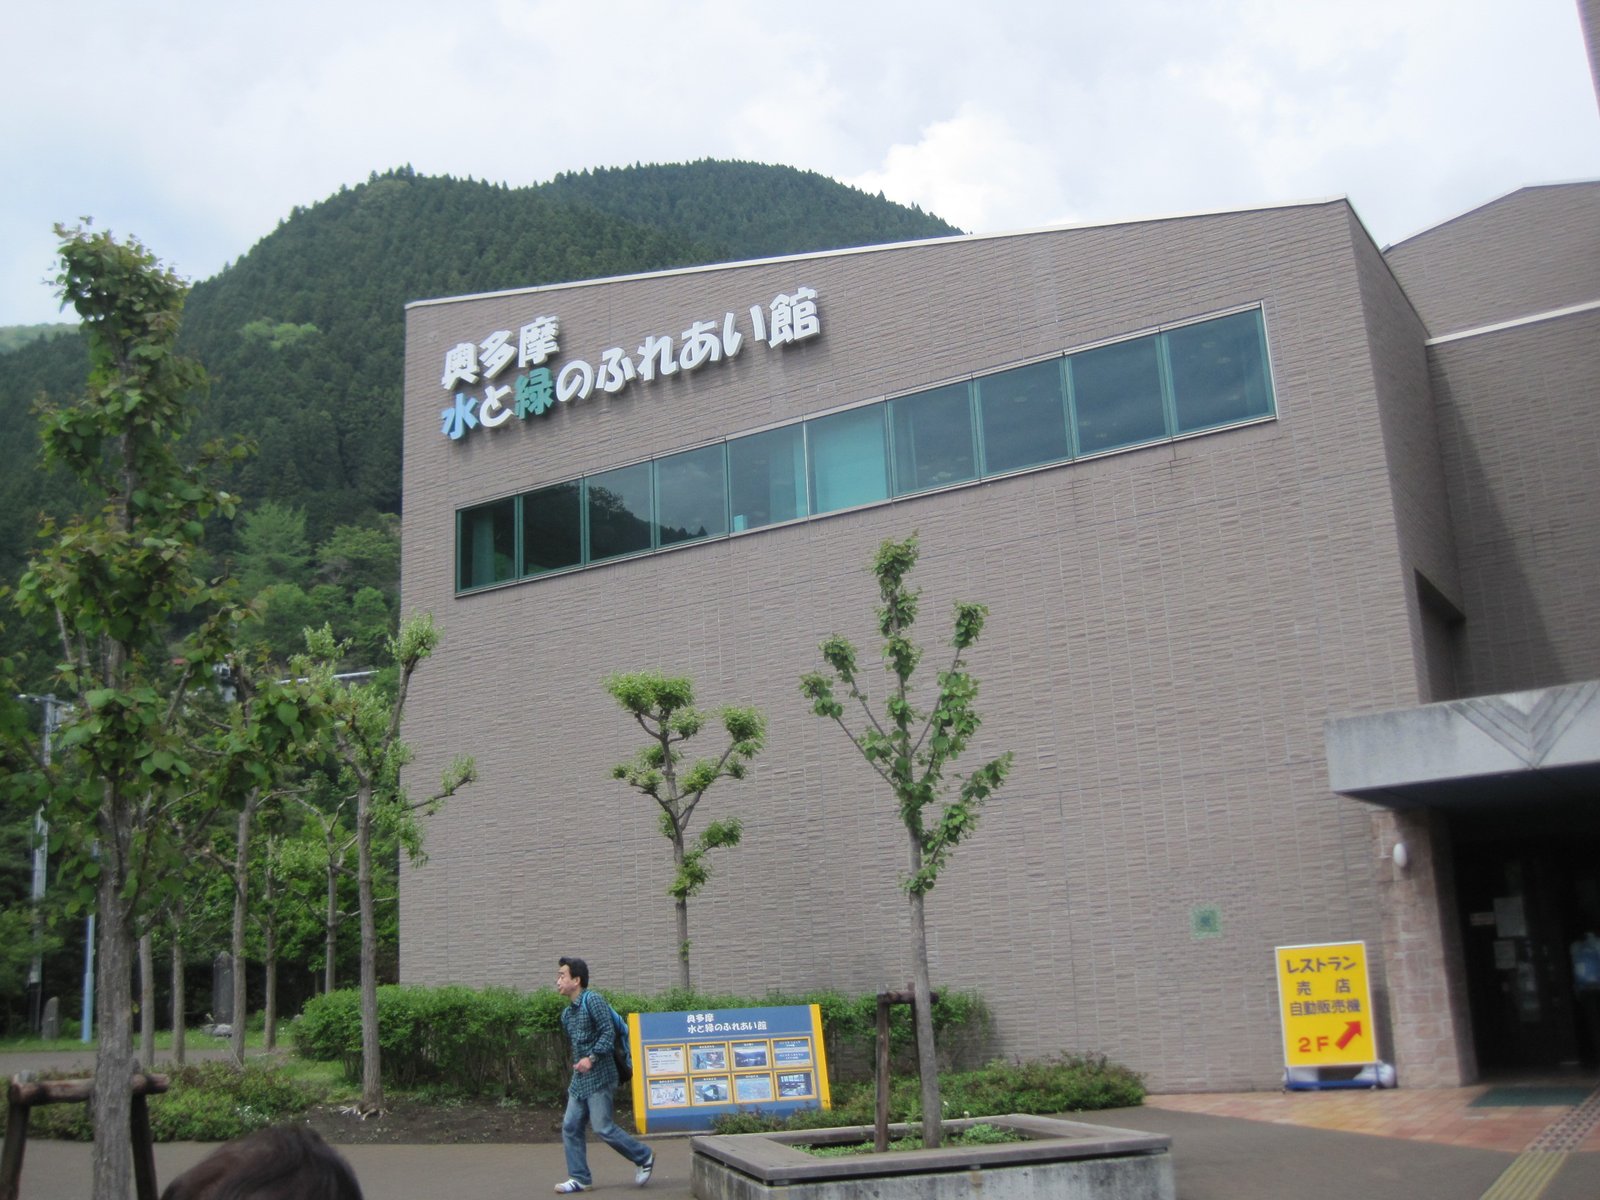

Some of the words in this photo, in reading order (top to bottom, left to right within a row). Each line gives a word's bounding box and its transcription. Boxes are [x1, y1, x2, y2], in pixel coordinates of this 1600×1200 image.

[441, 315, 561, 390] 奥多摩
[441, 286, 822, 440] 水と緑のふれあい館
[1286, 956, 1357, 974] レストラン
[1290, 998, 1361, 1016] 自動販売機
